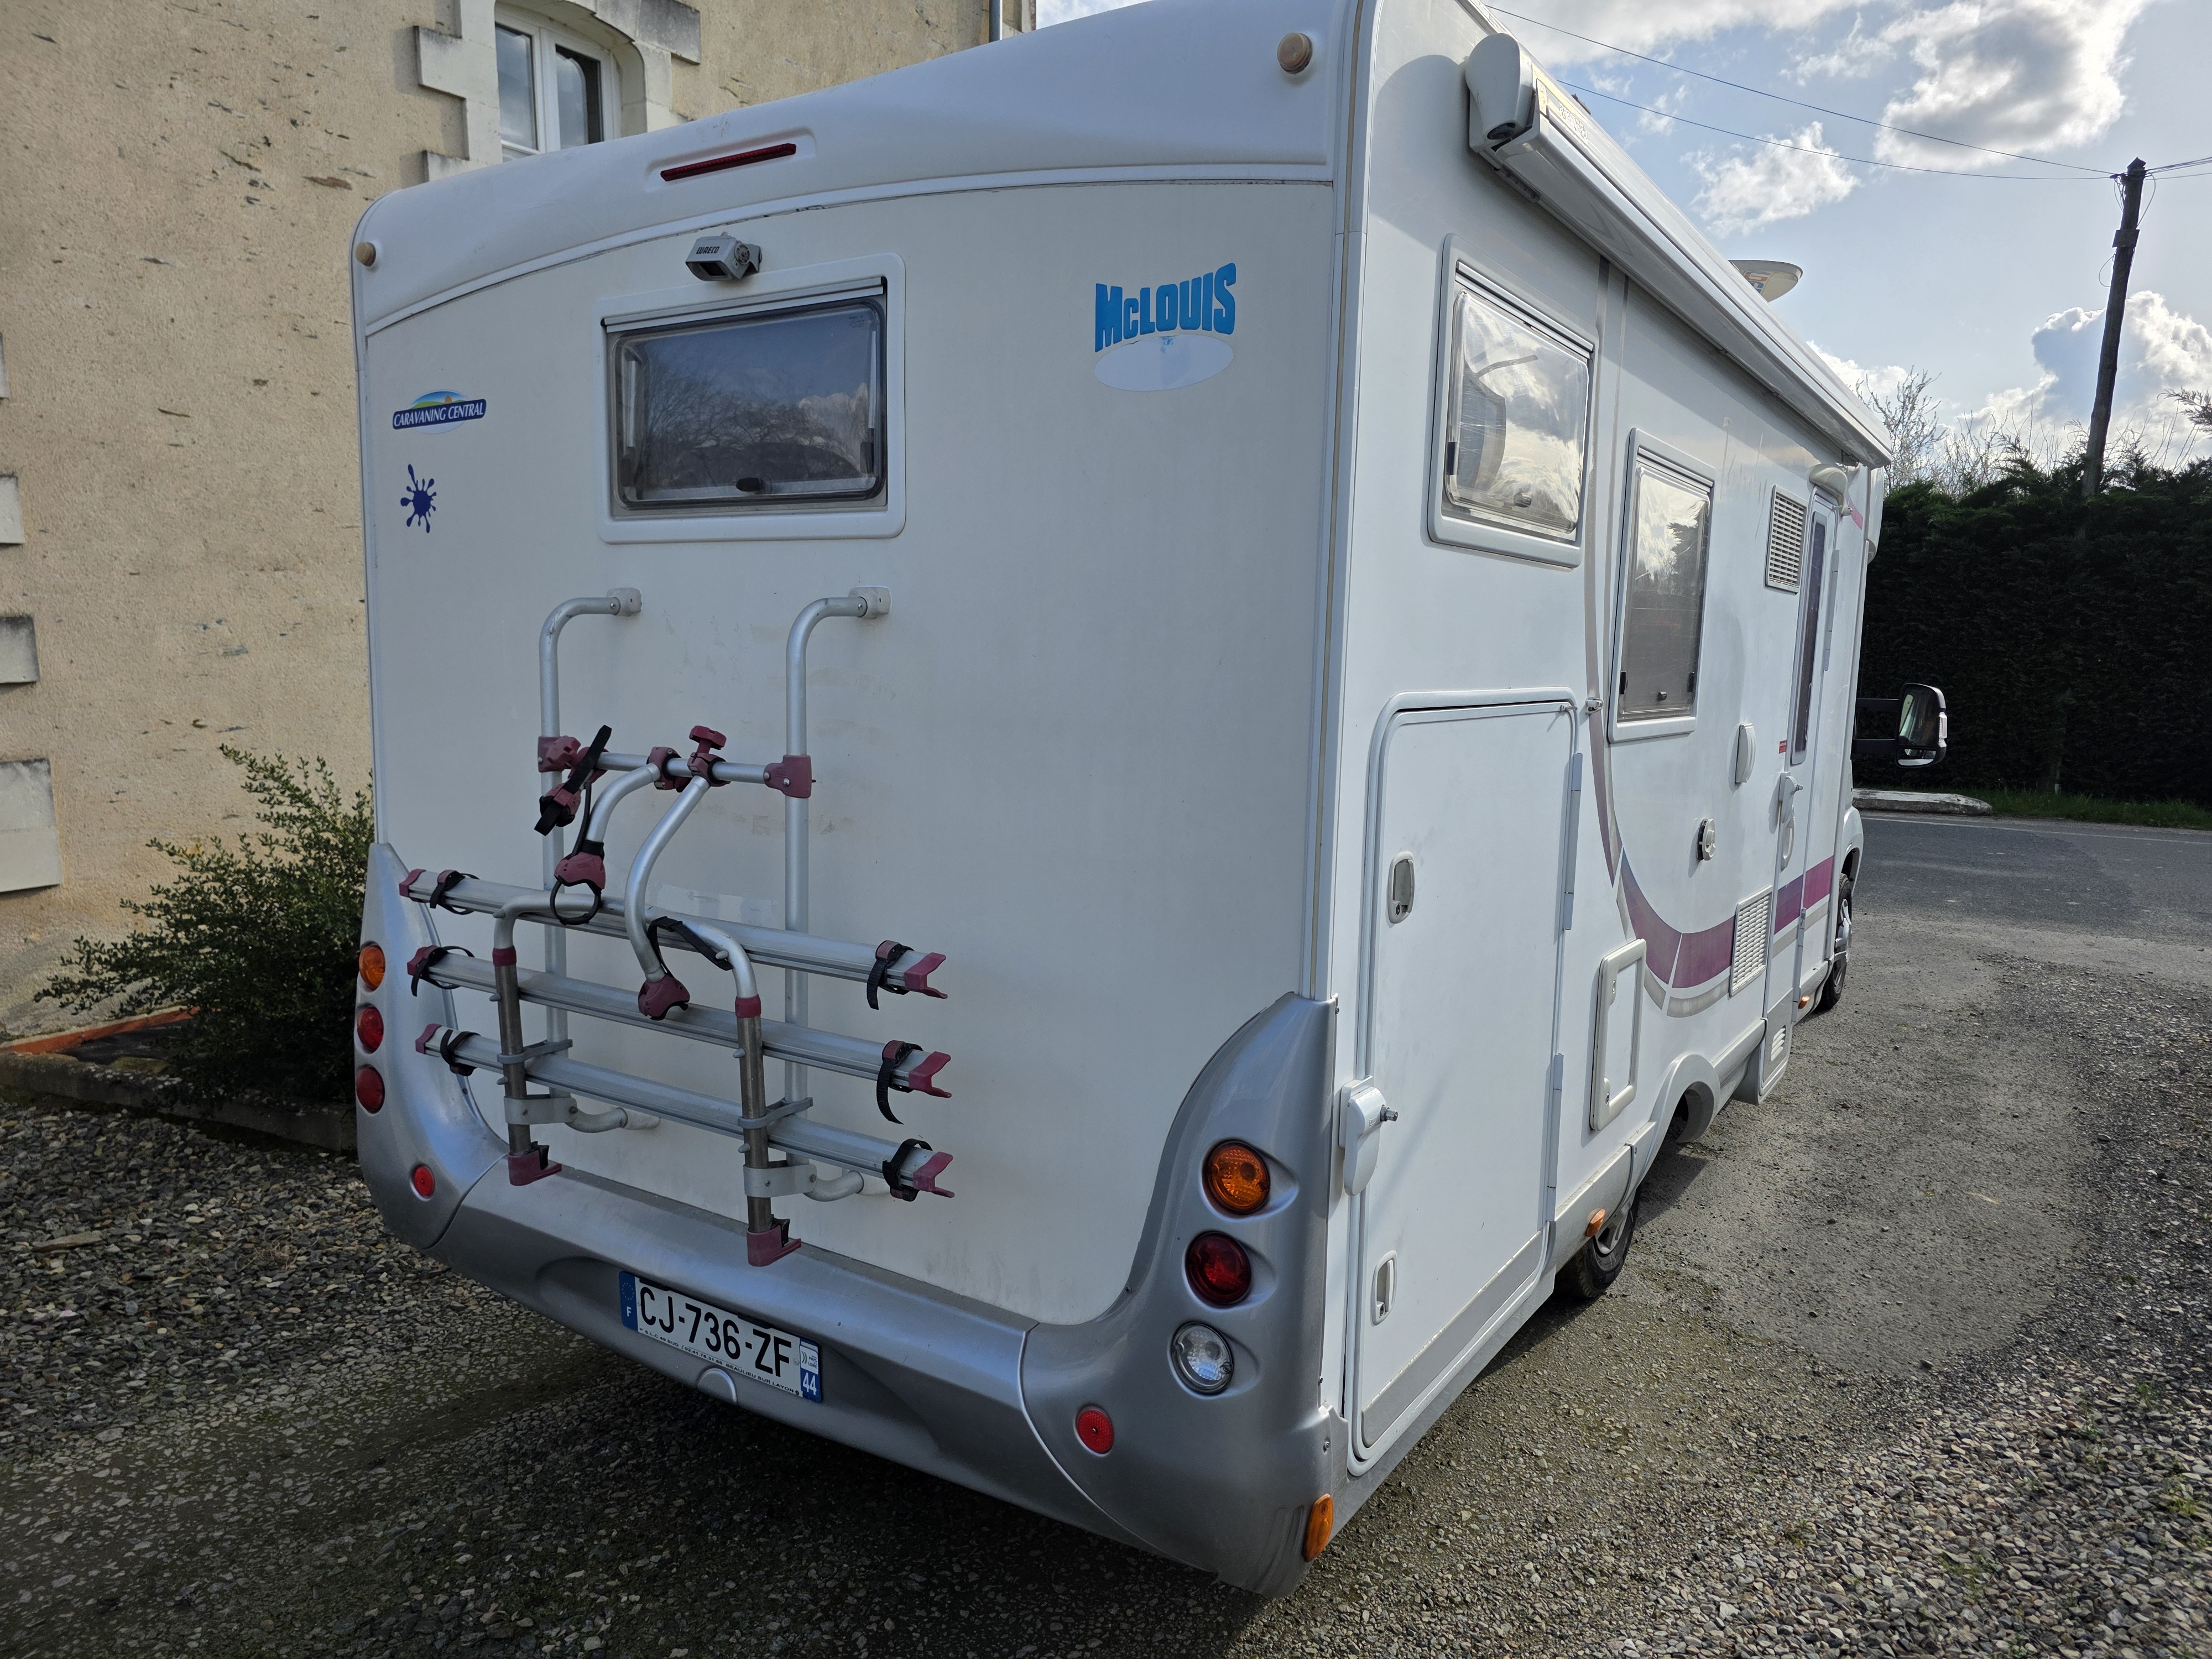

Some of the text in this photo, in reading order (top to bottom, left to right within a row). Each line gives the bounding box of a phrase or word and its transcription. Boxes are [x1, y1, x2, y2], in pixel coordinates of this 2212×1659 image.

[696, 246, 720, 254] WAECO
[1094, 262, 1237, 353] McLOUIS
[394, 402, 484, 427] CARAVANING CENTRAL
[627, 1306, 632, 1317] F
[640, 1286, 792, 1378] CJ-736-ZF
[726, 1363, 756, 1378] BEAULIEU
[758, 1376, 771, 1384] SUR
[772, 1381, 794, 1393] LAYON
[802, 1372, 817, 1395] 44
